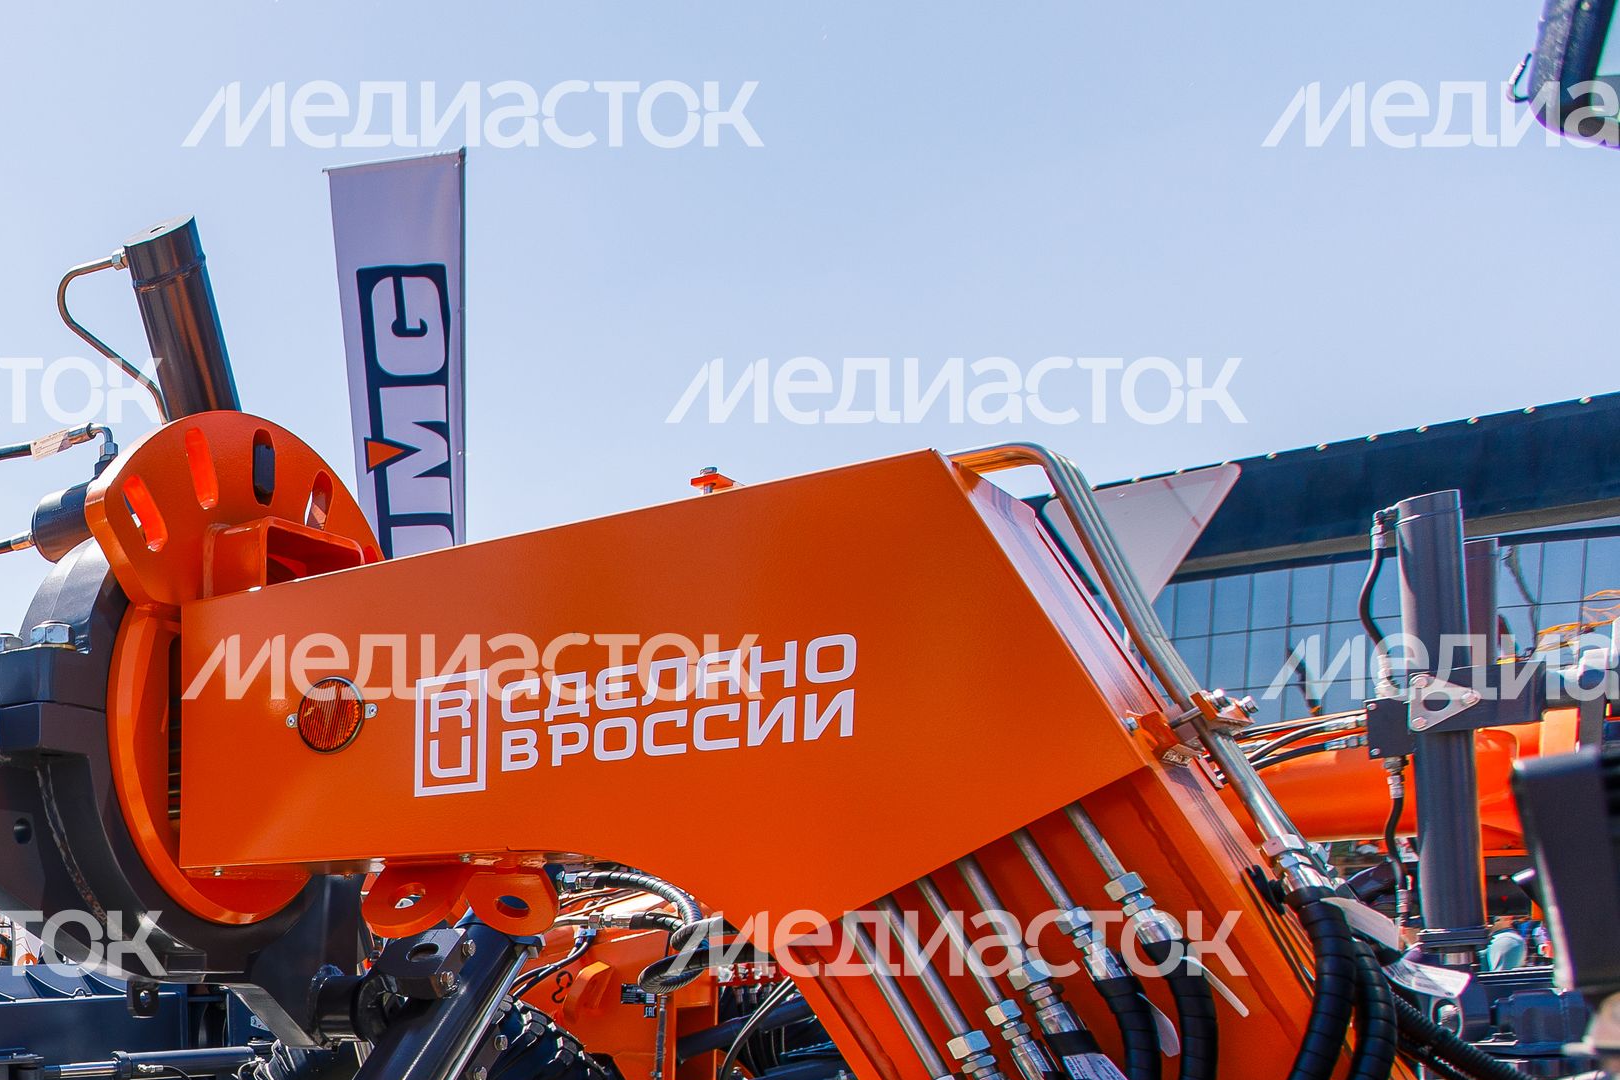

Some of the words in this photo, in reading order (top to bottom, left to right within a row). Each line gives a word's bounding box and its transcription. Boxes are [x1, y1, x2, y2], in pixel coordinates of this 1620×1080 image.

[500, 633, 857, 724] СДЕЛАНО
[500, 728, 540, 772] В
[546, 688, 856, 767] РОССИИ
